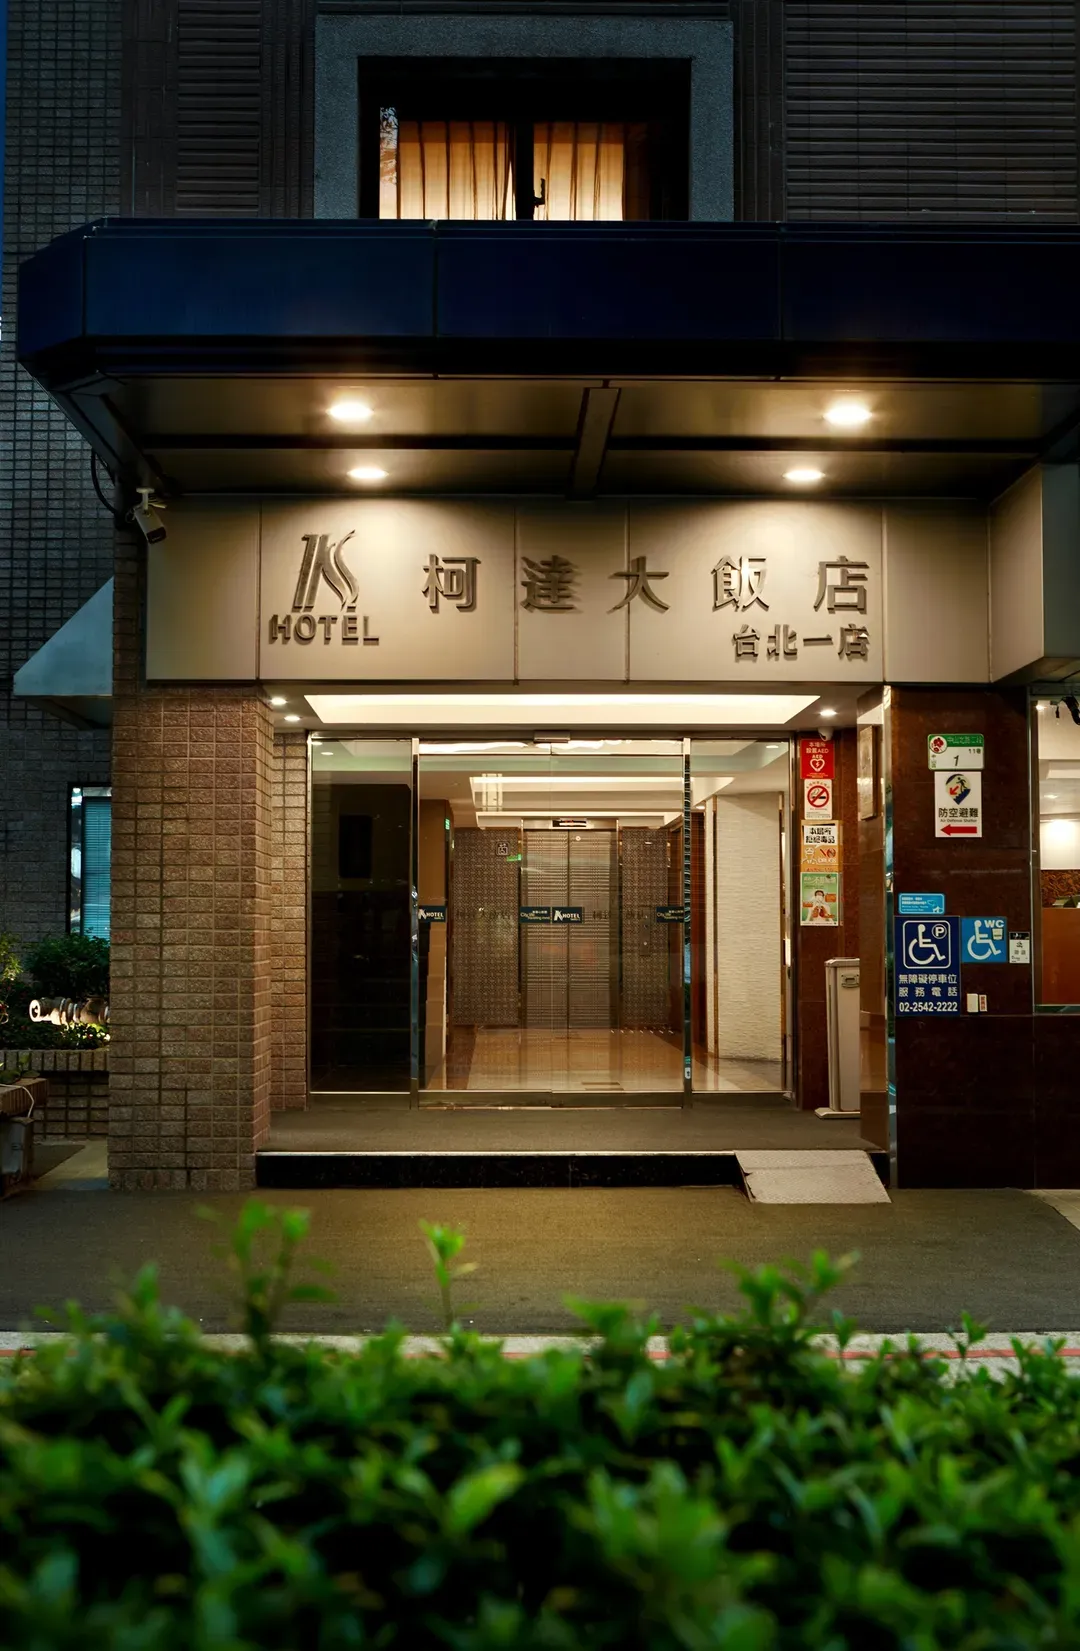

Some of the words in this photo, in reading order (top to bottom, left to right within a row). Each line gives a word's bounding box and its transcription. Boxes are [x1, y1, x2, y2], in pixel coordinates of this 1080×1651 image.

[421, 553, 870, 613] 柯達大飯店
[269, 612, 380, 644] HOTEL
[732, 624, 870, 660] 台北一店
[953, 754, 960, 767] 1
[938, 807, 979, 818] 防空避難
[984, 919, 1005, 928] WC
[935, 926, 945, 937] P
[898, 974, 957, 984] 無障礙停車位
[898, 986, 958, 997] 服務電話
[898, 1002, 958, 1012] 02-2542-2222
